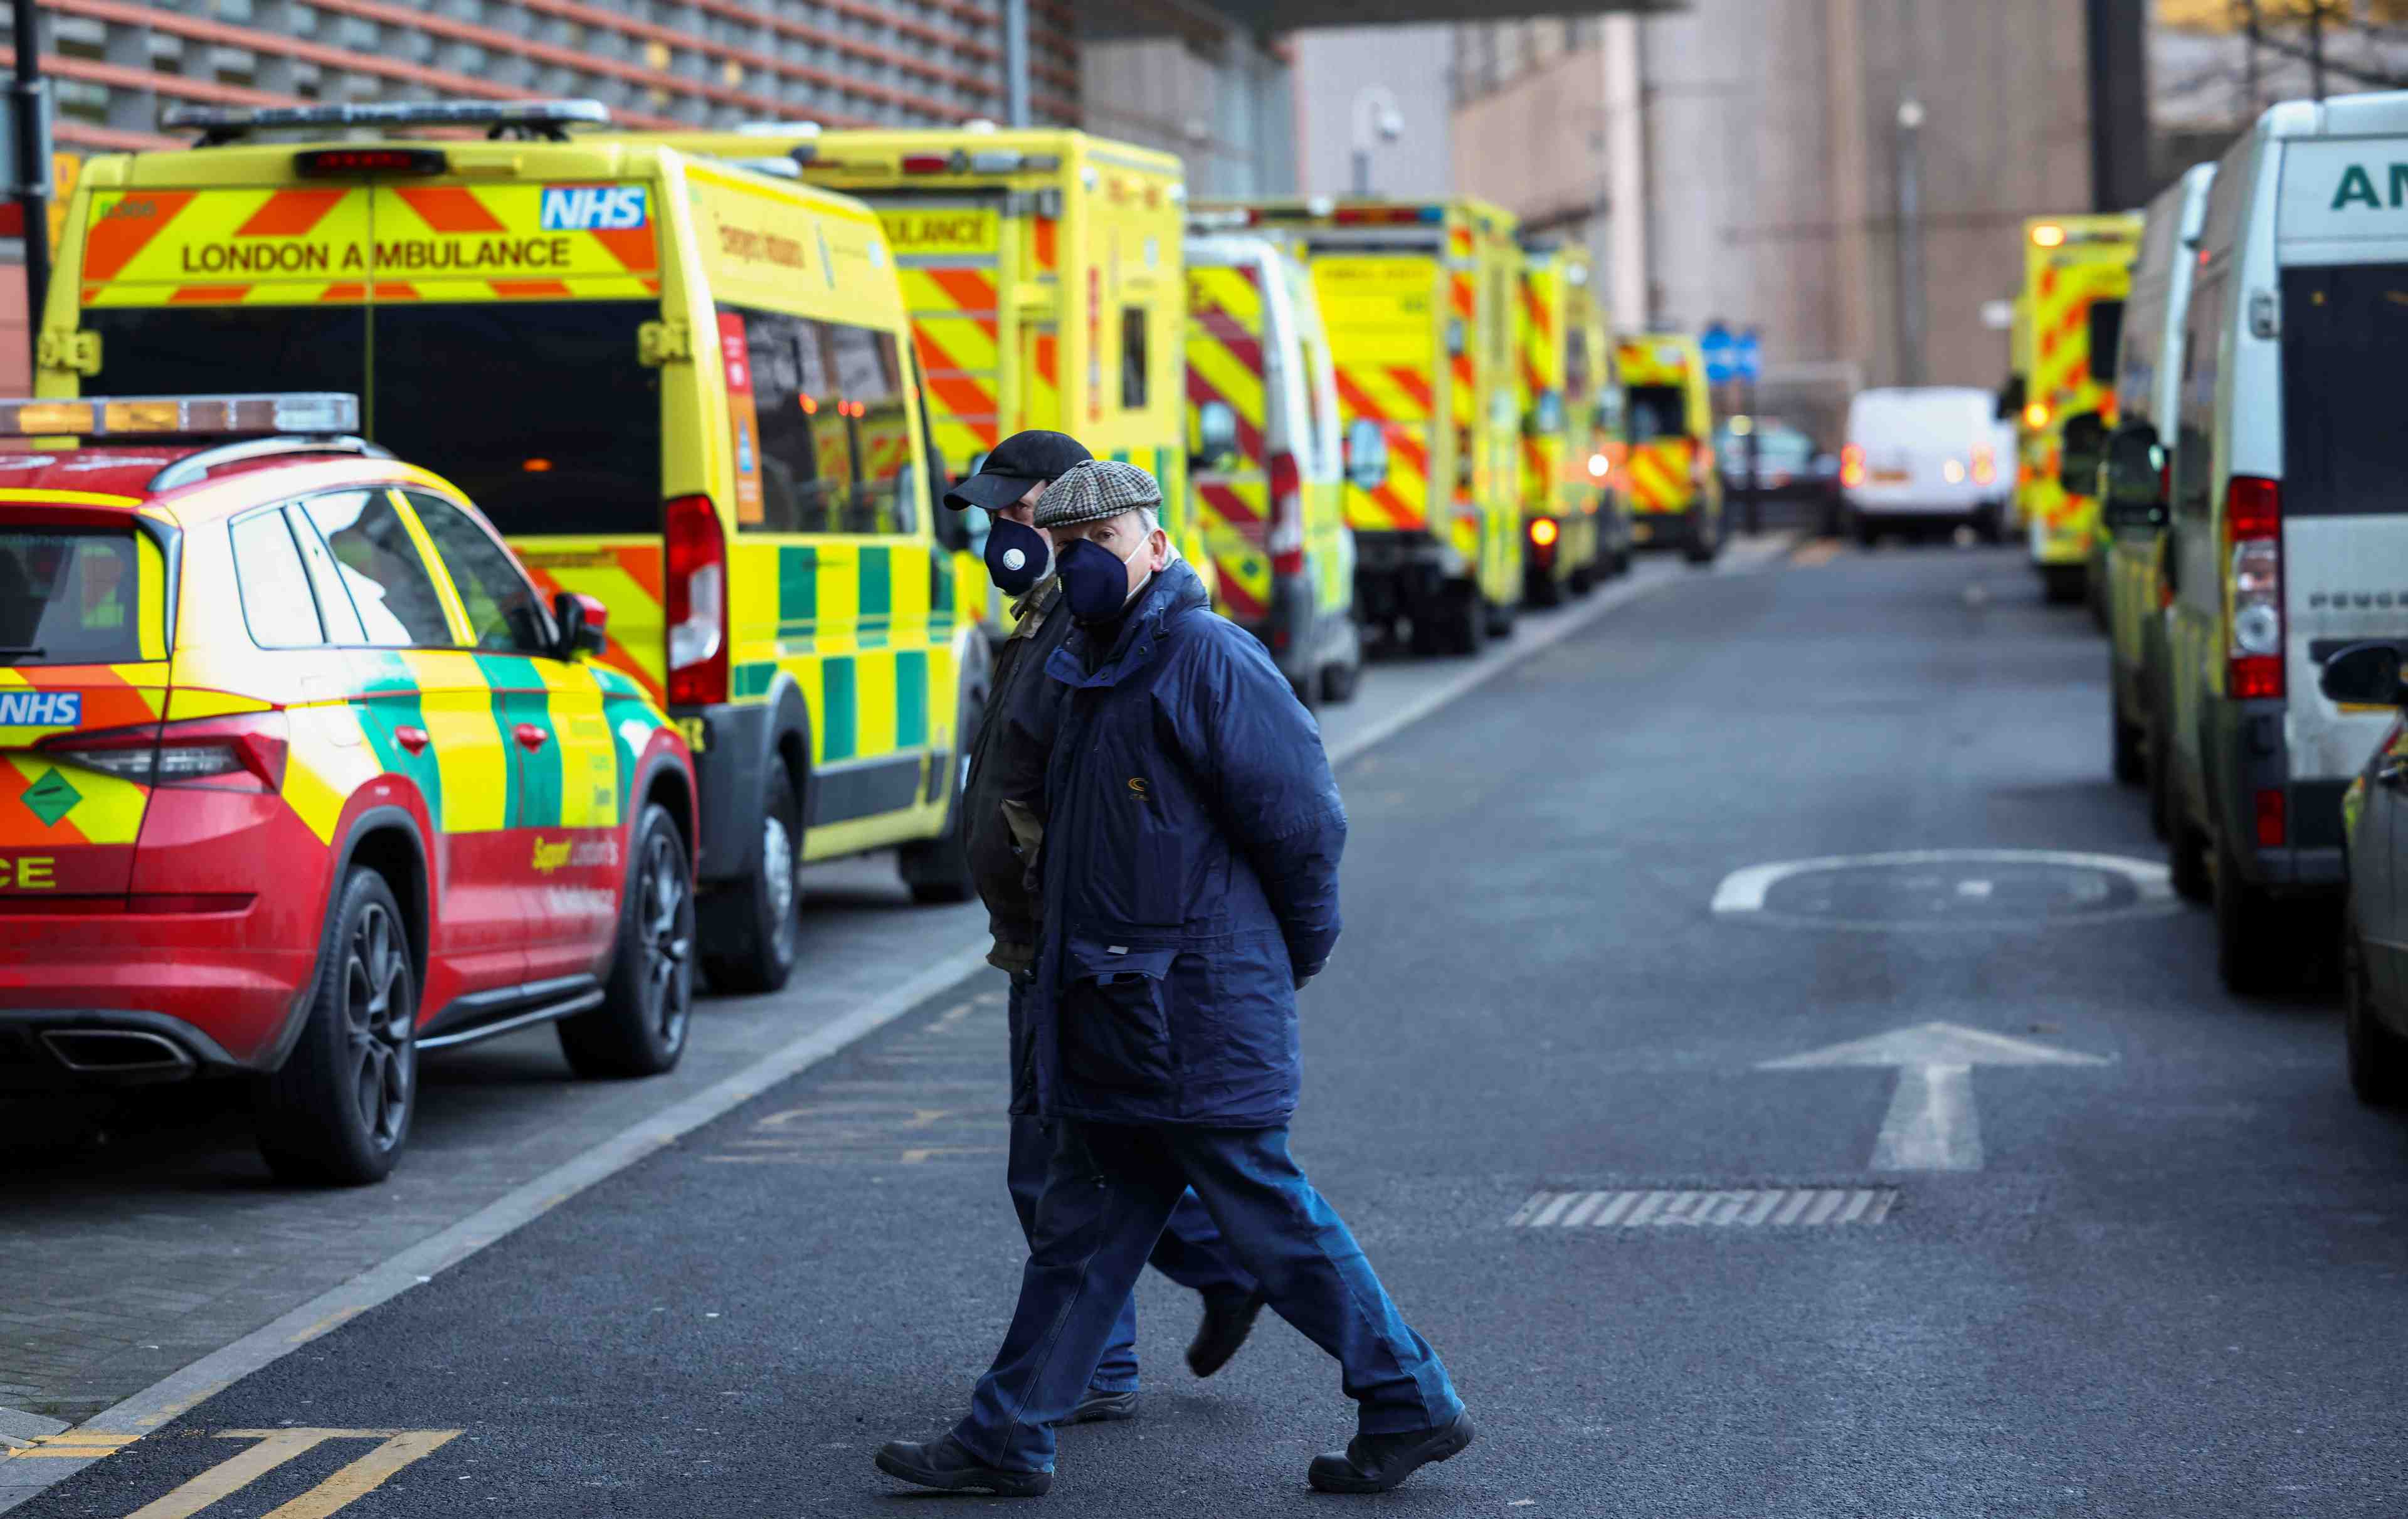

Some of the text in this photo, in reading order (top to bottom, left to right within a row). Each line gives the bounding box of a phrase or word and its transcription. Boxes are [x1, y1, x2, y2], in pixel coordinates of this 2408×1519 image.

[541, 188, 645, 229] NHS
[182, 236, 571, 272] LONDON AMBULANCE
[0, 692, 79, 724] NHS
